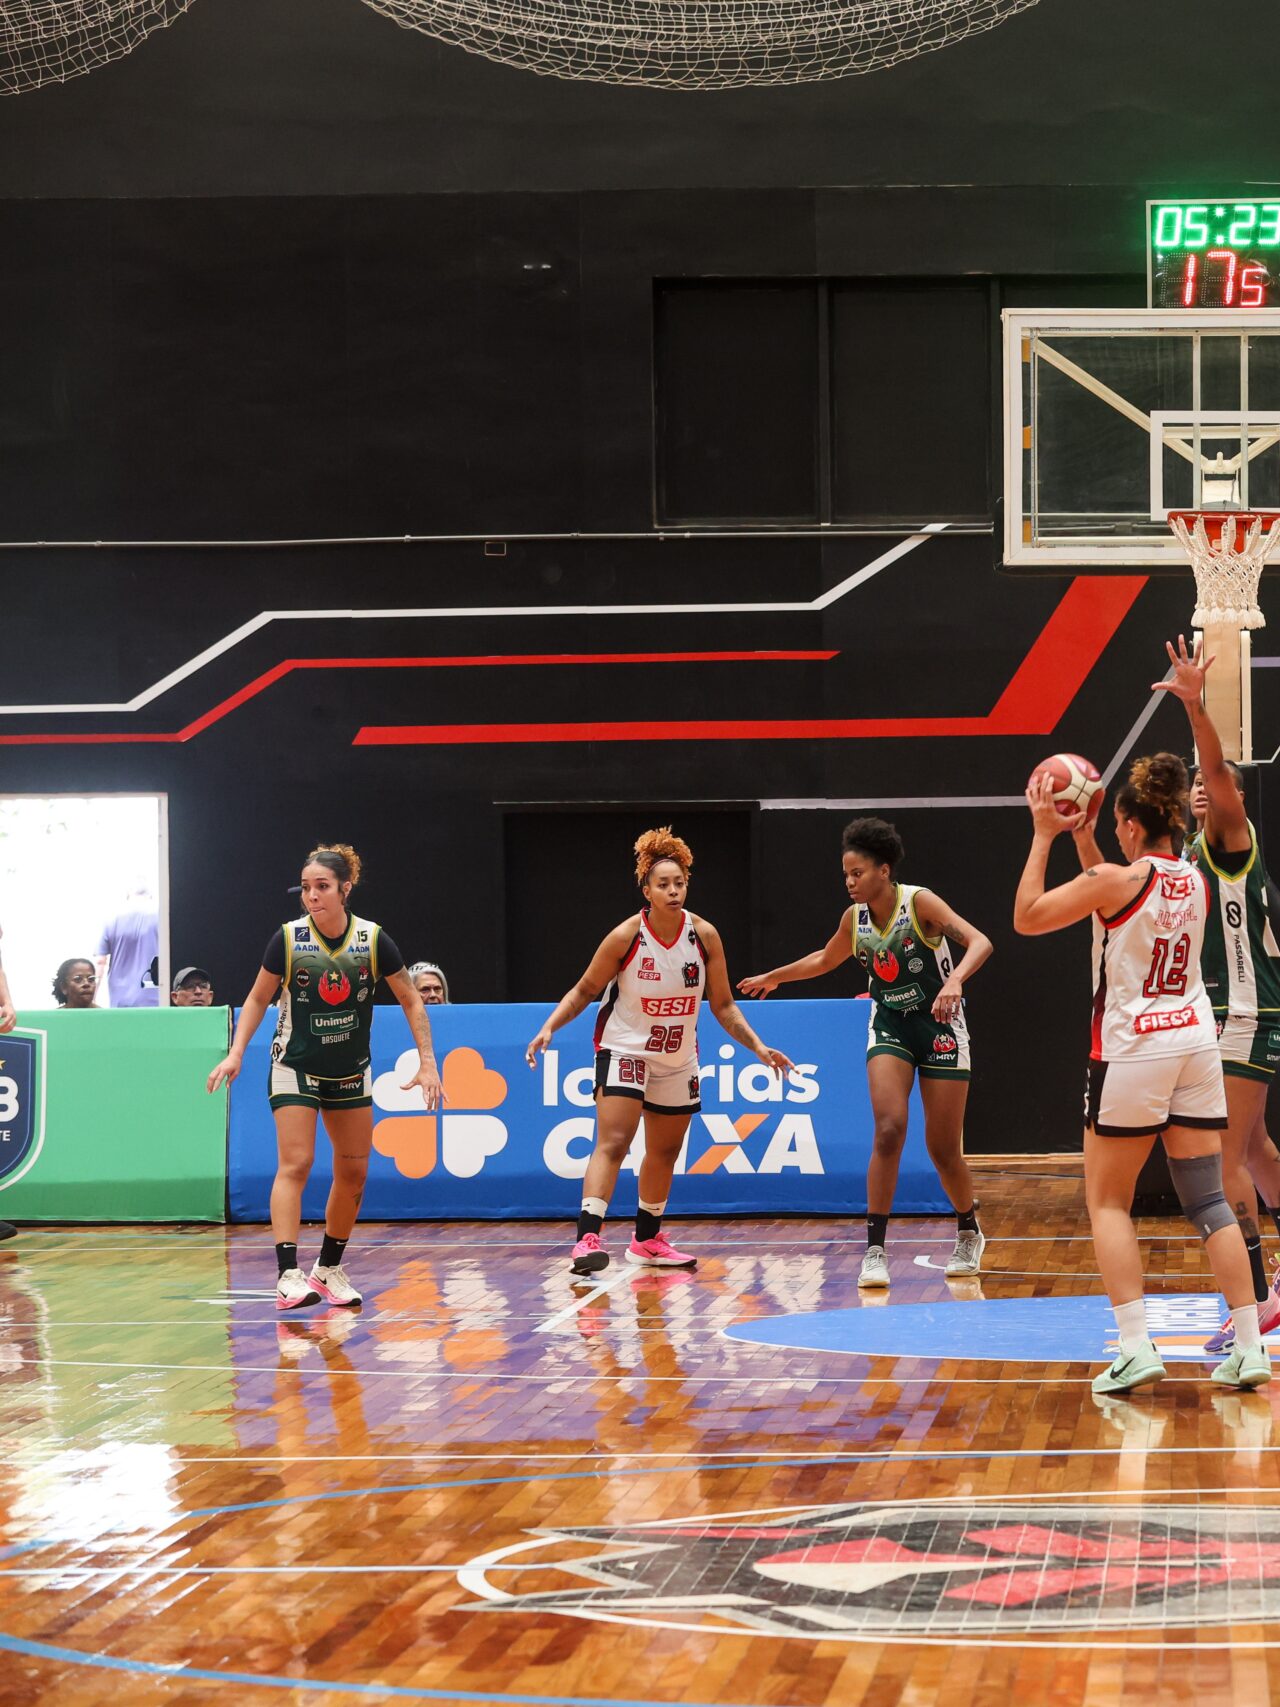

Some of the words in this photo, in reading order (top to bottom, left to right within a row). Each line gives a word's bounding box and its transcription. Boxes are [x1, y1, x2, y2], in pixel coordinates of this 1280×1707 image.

[357, 930, 368, 942] 15
[1142, 933, 1191, 998] 12
[1233, 934, 1245, 983] PASSARELLI
[884, 989, 917, 1002] Unimed
[646, 999, 692, 1015] SESI
[315, 1014, 354, 1027] Unimed
[1139, 1009, 1192, 1031] FIESP
[321, 1032, 350, 1044] BASQUETE
[644, 1025, 685, 1053] 25
